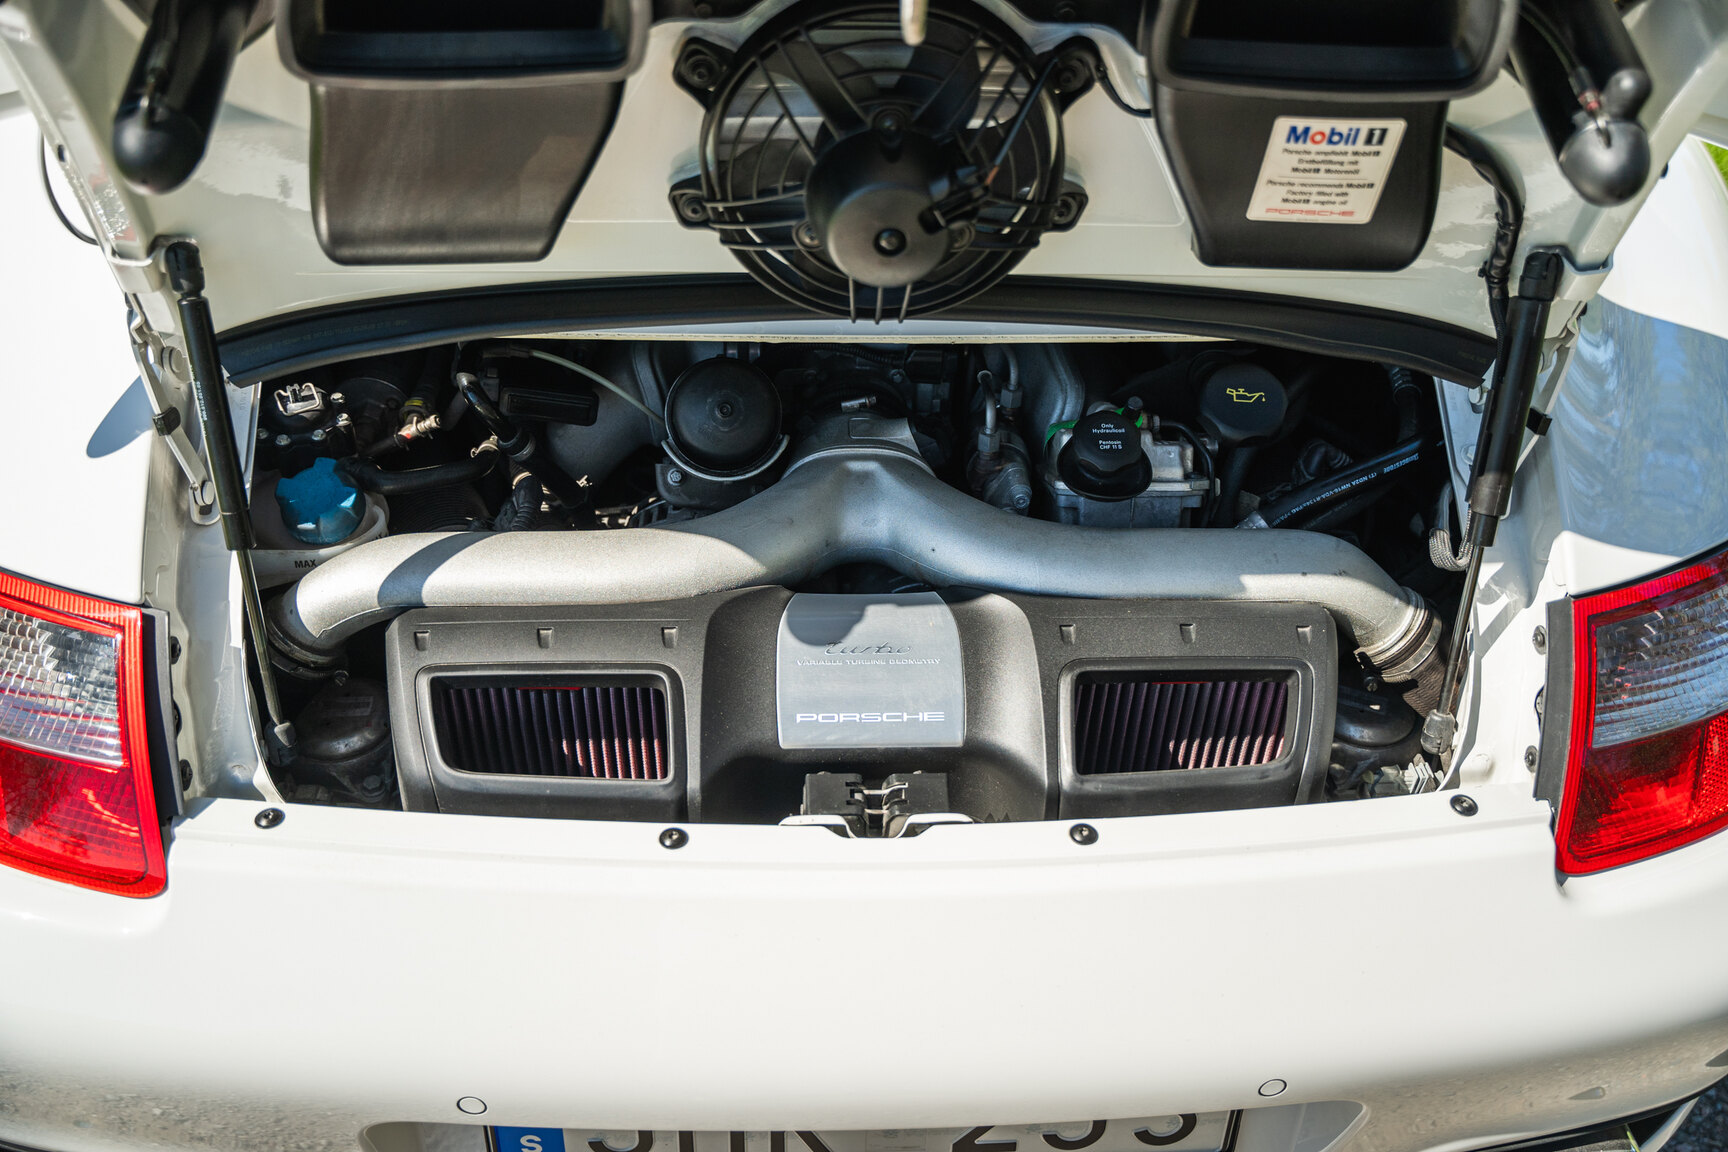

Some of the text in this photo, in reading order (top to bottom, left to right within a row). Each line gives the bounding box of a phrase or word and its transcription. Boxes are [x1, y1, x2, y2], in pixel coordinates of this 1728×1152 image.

[1286, 125, 1386, 146] Mobil 1
[1265, 207, 1355, 217] PORSCHE
[294, 559, 318, 569] MAX
[824, 640, 912, 656] Turbo
[889, 658, 941, 666] GEOMETRY
[796, 711, 945, 724] PORSCHE
[520, 1134, 543, 1152] S
